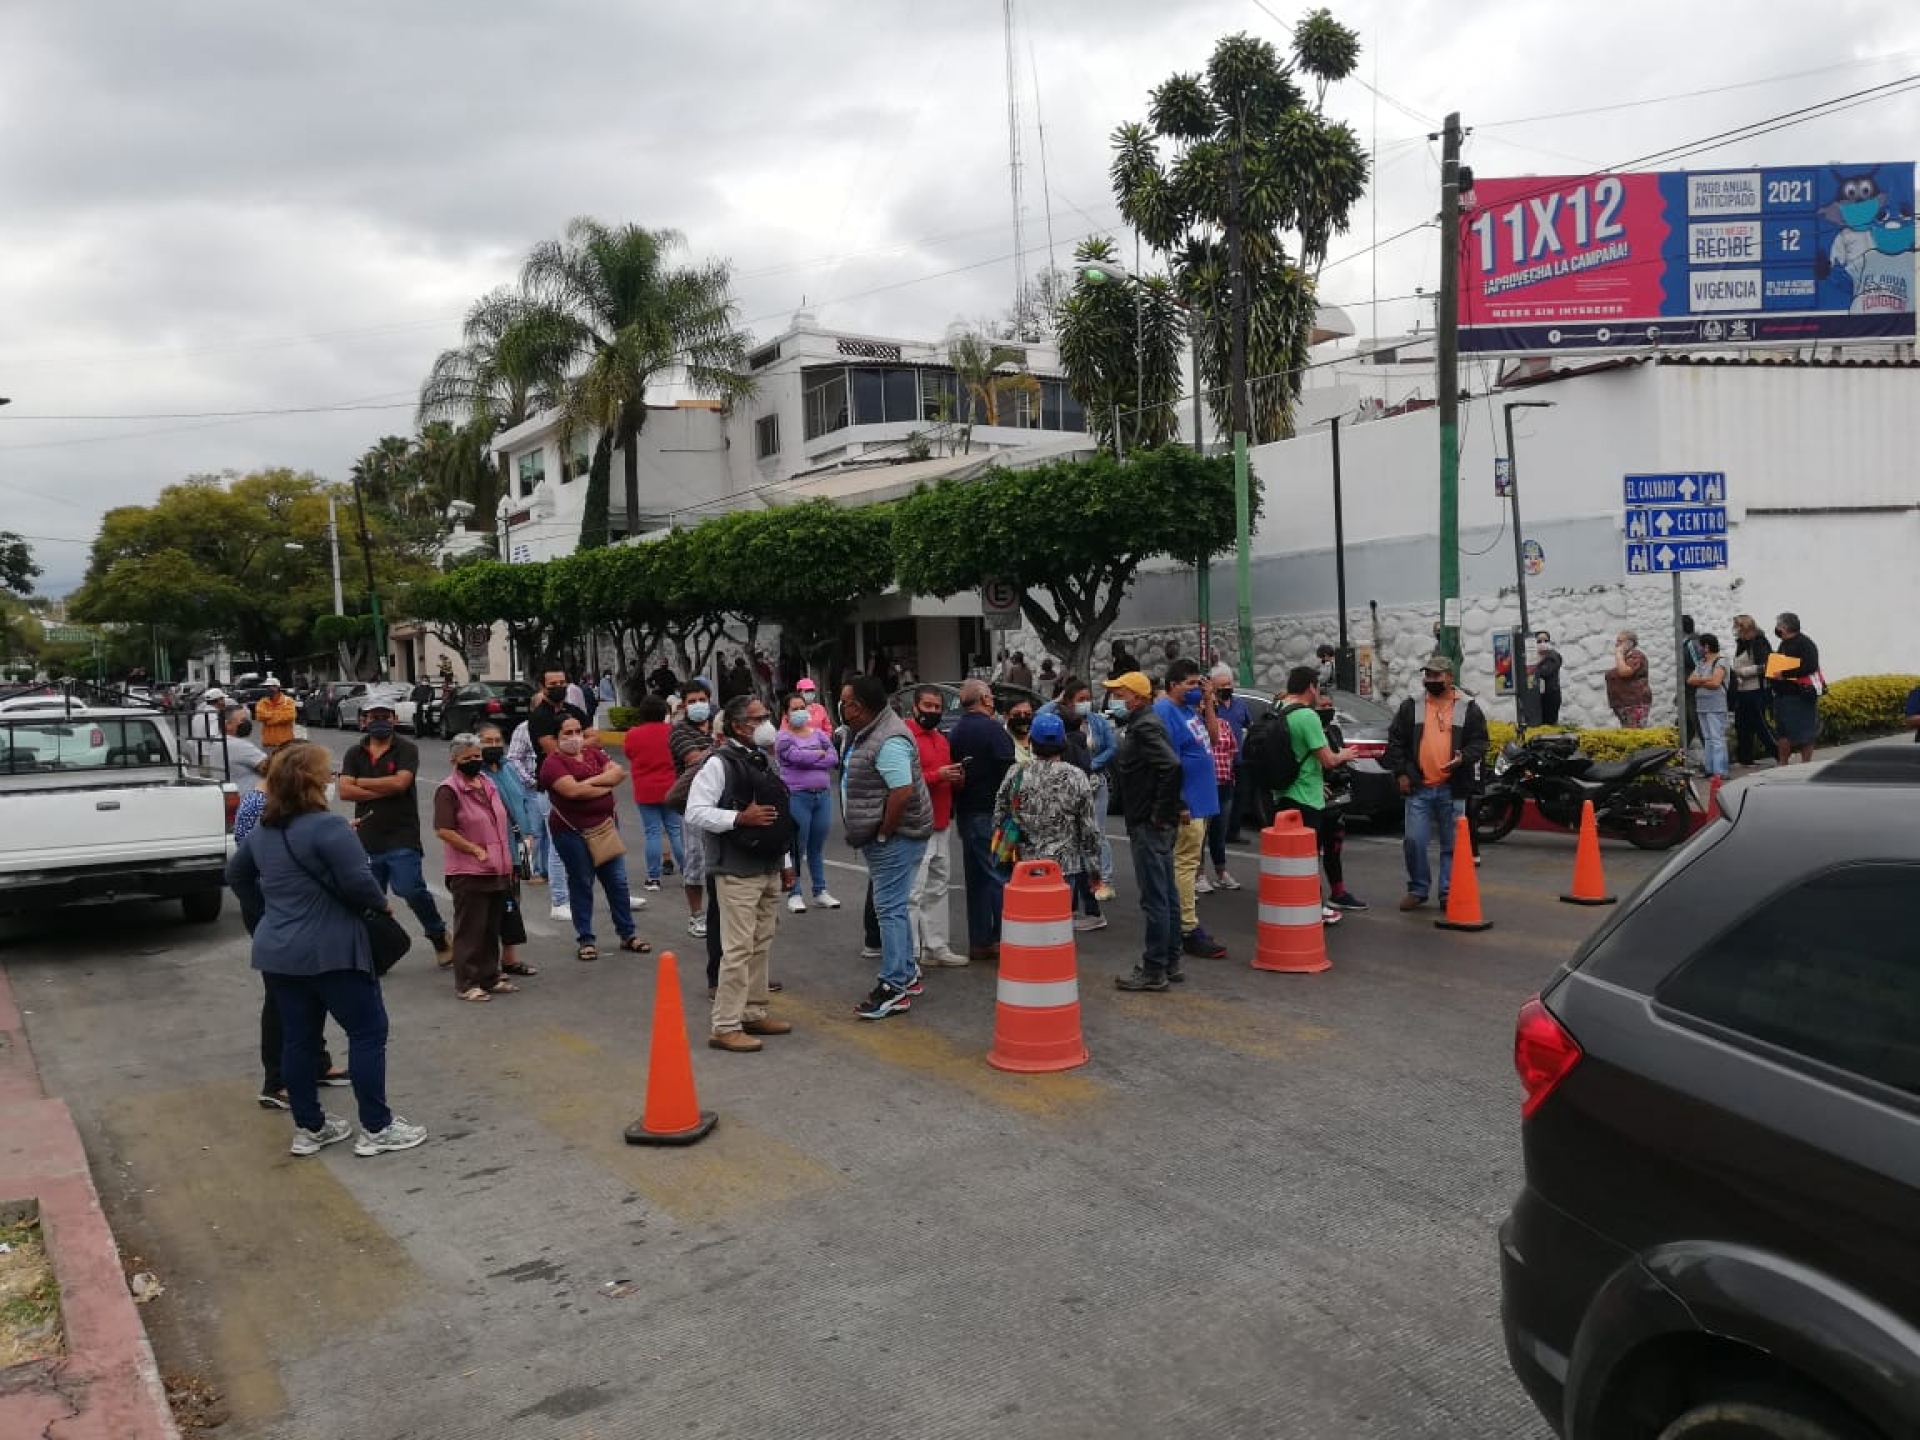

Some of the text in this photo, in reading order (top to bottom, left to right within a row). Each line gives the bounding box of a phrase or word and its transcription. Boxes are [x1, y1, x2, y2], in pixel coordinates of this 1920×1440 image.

[1696, 181, 1754, 194] PAGO ANUAL
[1768, 180, 1811, 203] 2021
[1695, 192, 1756, 208] ANTICIPADO
[1471, 177, 1625, 271] 11X12
[1778, 229, 1801, 251] 12
[1554, 260, 1570, 276] LA
[1571, 242, 1628, 270] CAMPAÑA!
[1695, 280, 1756, 300] VIGENCIA
[1639, 480, 1676, 499] CALVARIO
[1677, 511, 1724, 531] CENTRO
[1677, 546, 1725, 565] CATEDRAL
